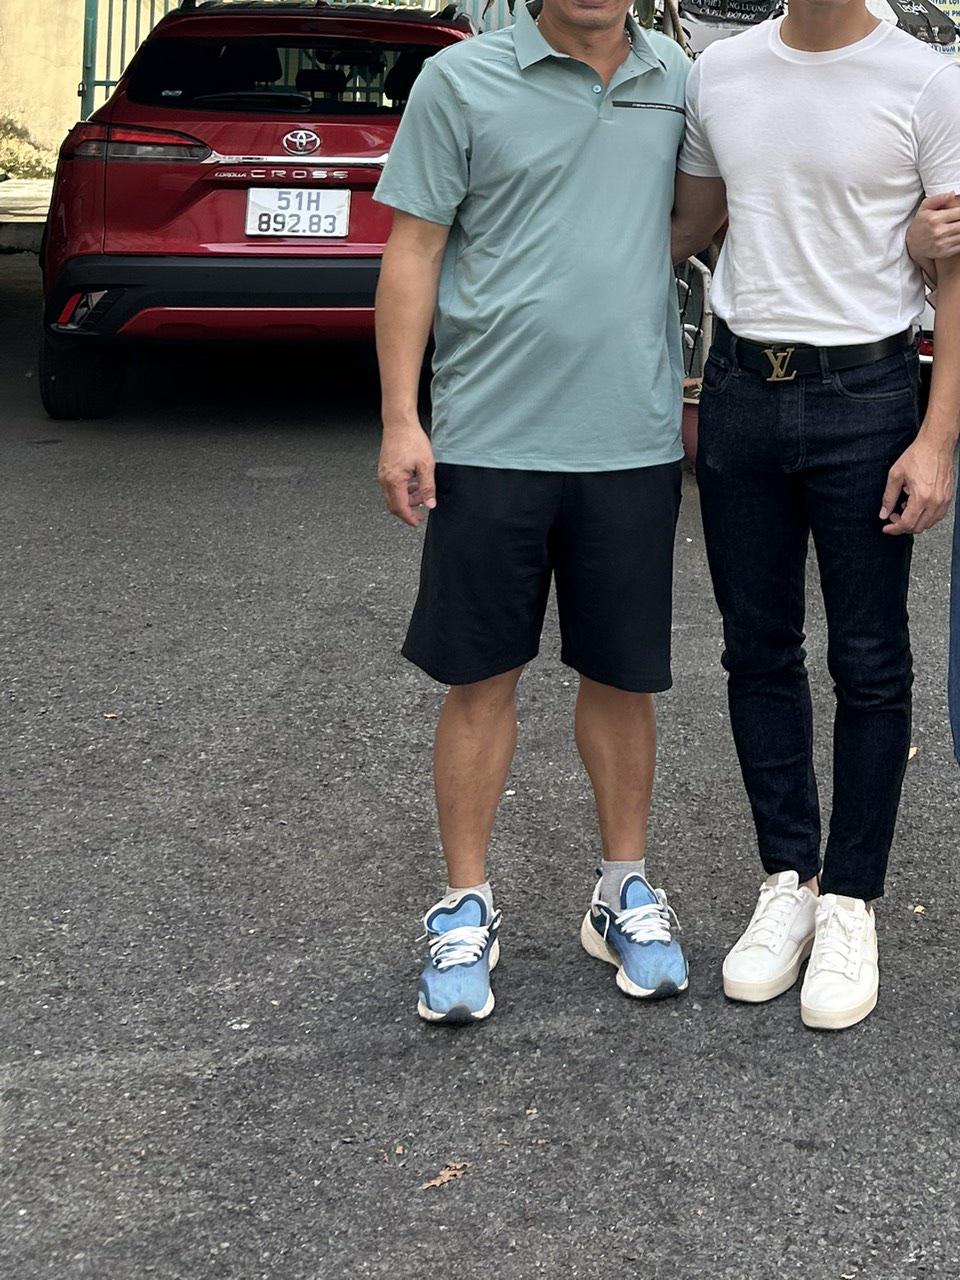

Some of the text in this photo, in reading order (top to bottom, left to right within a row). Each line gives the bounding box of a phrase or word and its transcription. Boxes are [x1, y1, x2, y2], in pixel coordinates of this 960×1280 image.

[250, 169, 349, 179] CROSS
[277, 191, 320, 211] 51H
[258, 213, 337, 234] 892.83
